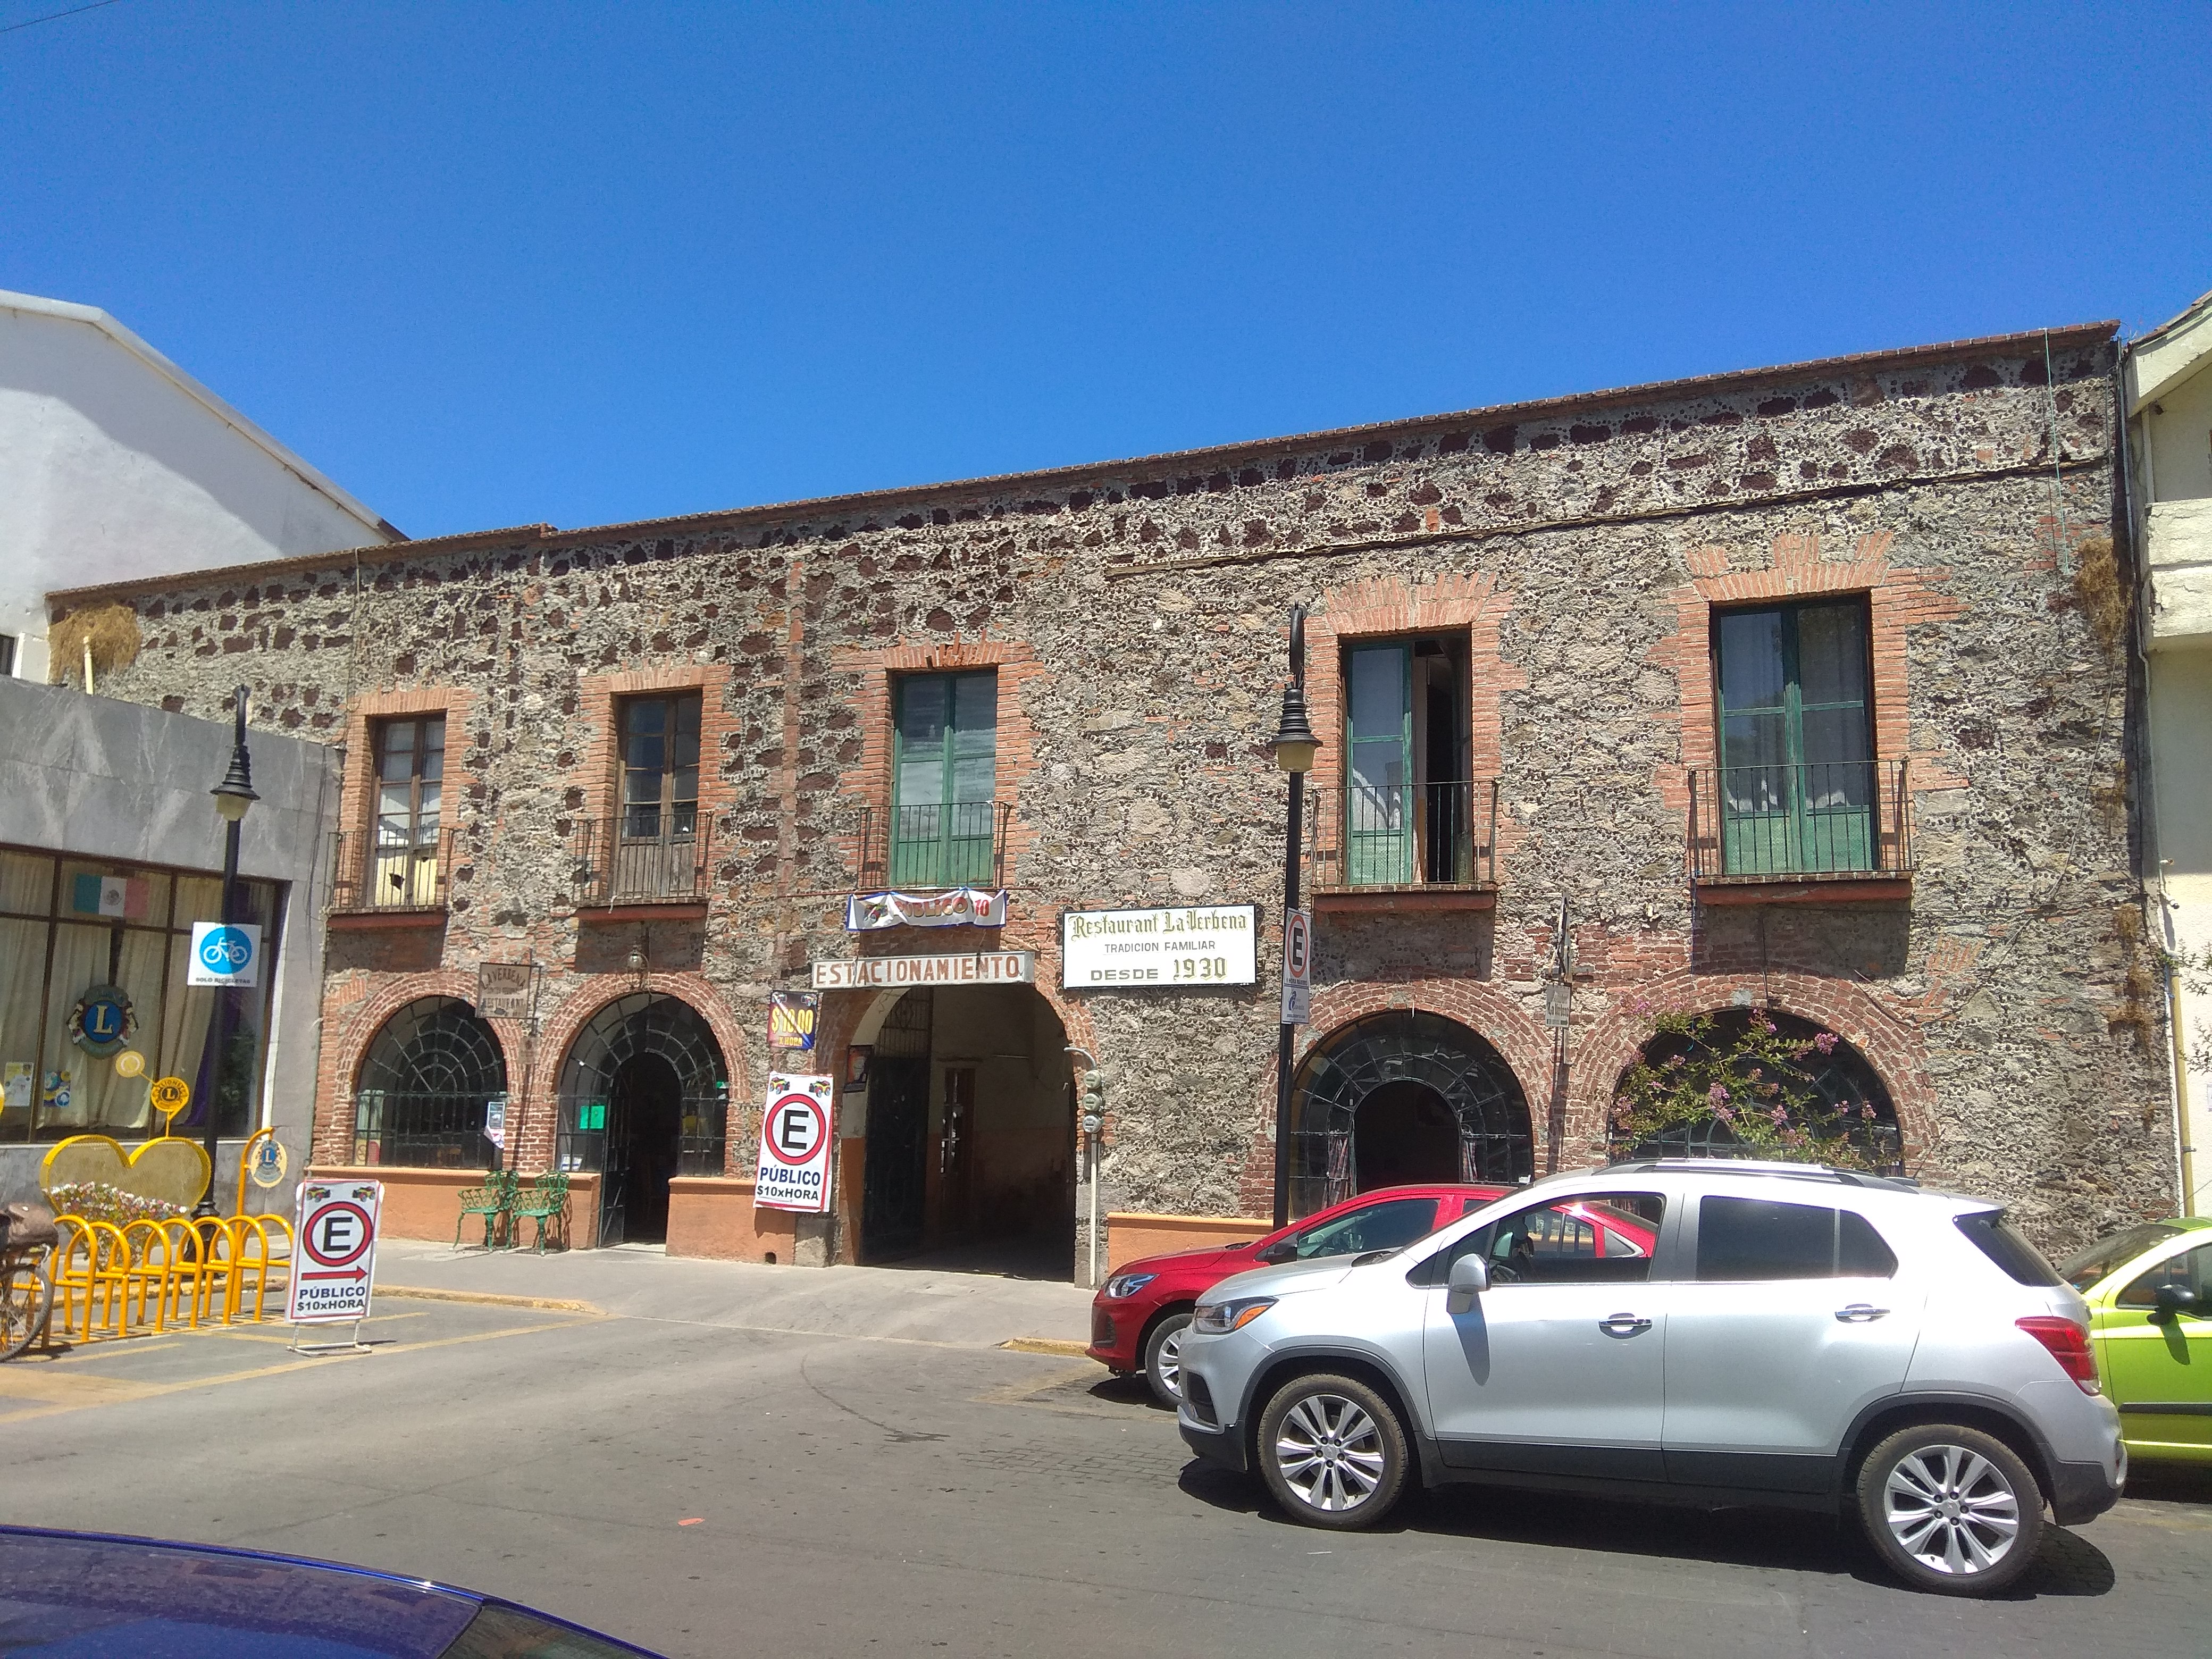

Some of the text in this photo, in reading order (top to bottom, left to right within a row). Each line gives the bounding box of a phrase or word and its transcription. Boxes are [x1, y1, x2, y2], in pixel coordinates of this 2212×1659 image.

[1068, 914, 1159, 941] Restaurant
[1105, 941, 1216, 953] TRADICION FAMILIAR
[1293, 927, 1303, 966] E
[816, 956, 1020, 984] ESTACIONAMIENTO
[1091, 957, 1227, 981] DESDE 1930
[93, 1005, 113, 1034] L
[772, 1006, 780, 1034] $
[785, 1036, 802, 1046] HORA
[166, 1088, 175, 1099] L
[782, 1110, 809, 1150] E
[760, 1164, 820, 1186] PÚBLICO
[757, 1185, 819, 1201] $10xHORA
[323, 1217, 353, 1252] E
[299, 1286, 365, 1299] PÚBLICO
[297, 1299, 364, 1311] $10xHORA
